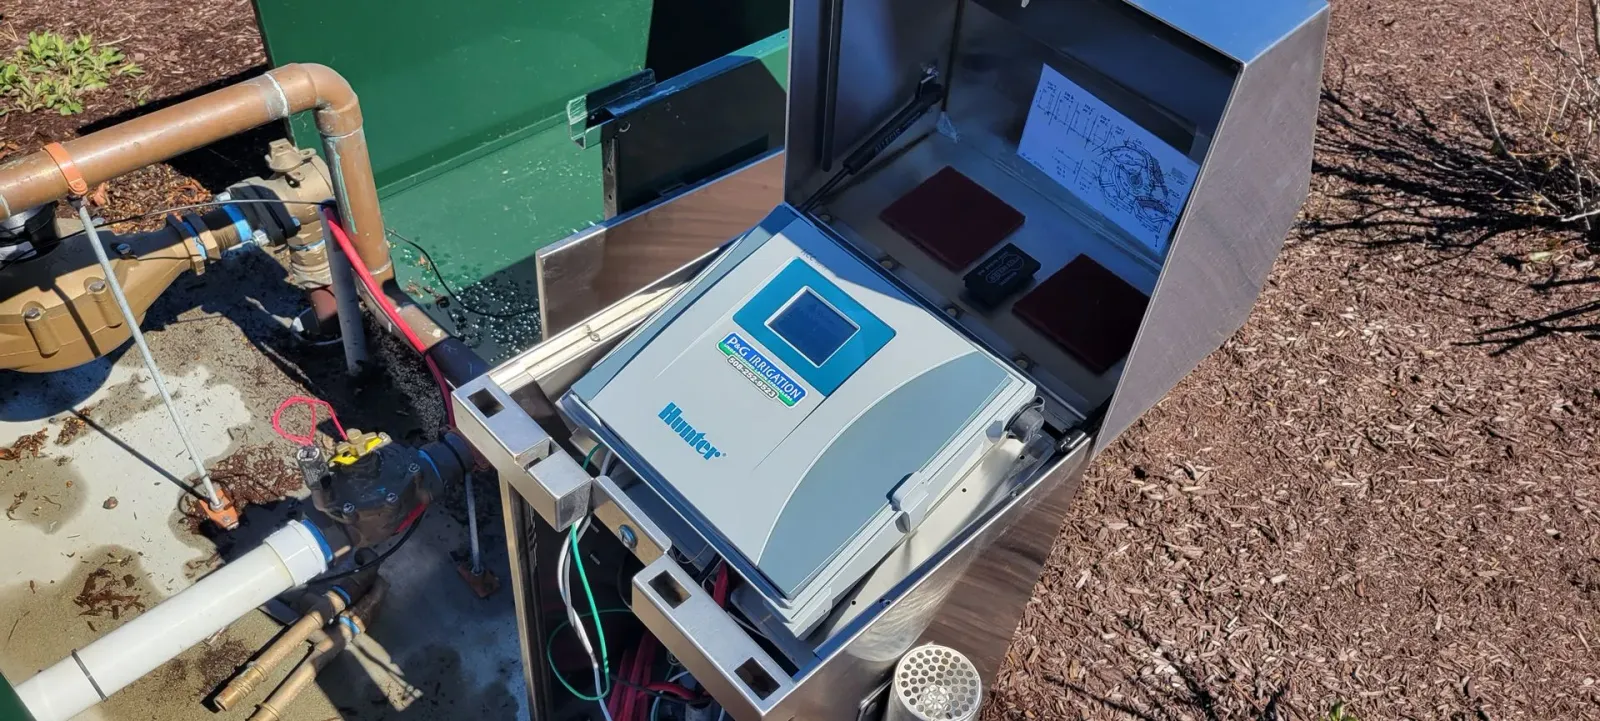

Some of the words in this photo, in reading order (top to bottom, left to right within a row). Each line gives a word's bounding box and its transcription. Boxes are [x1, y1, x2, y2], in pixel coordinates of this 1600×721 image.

[727, 337, 750, 356] P&G
[749, 354, 802, 398] IRRIGATION
[658, 402, 722, 460] Hunter
